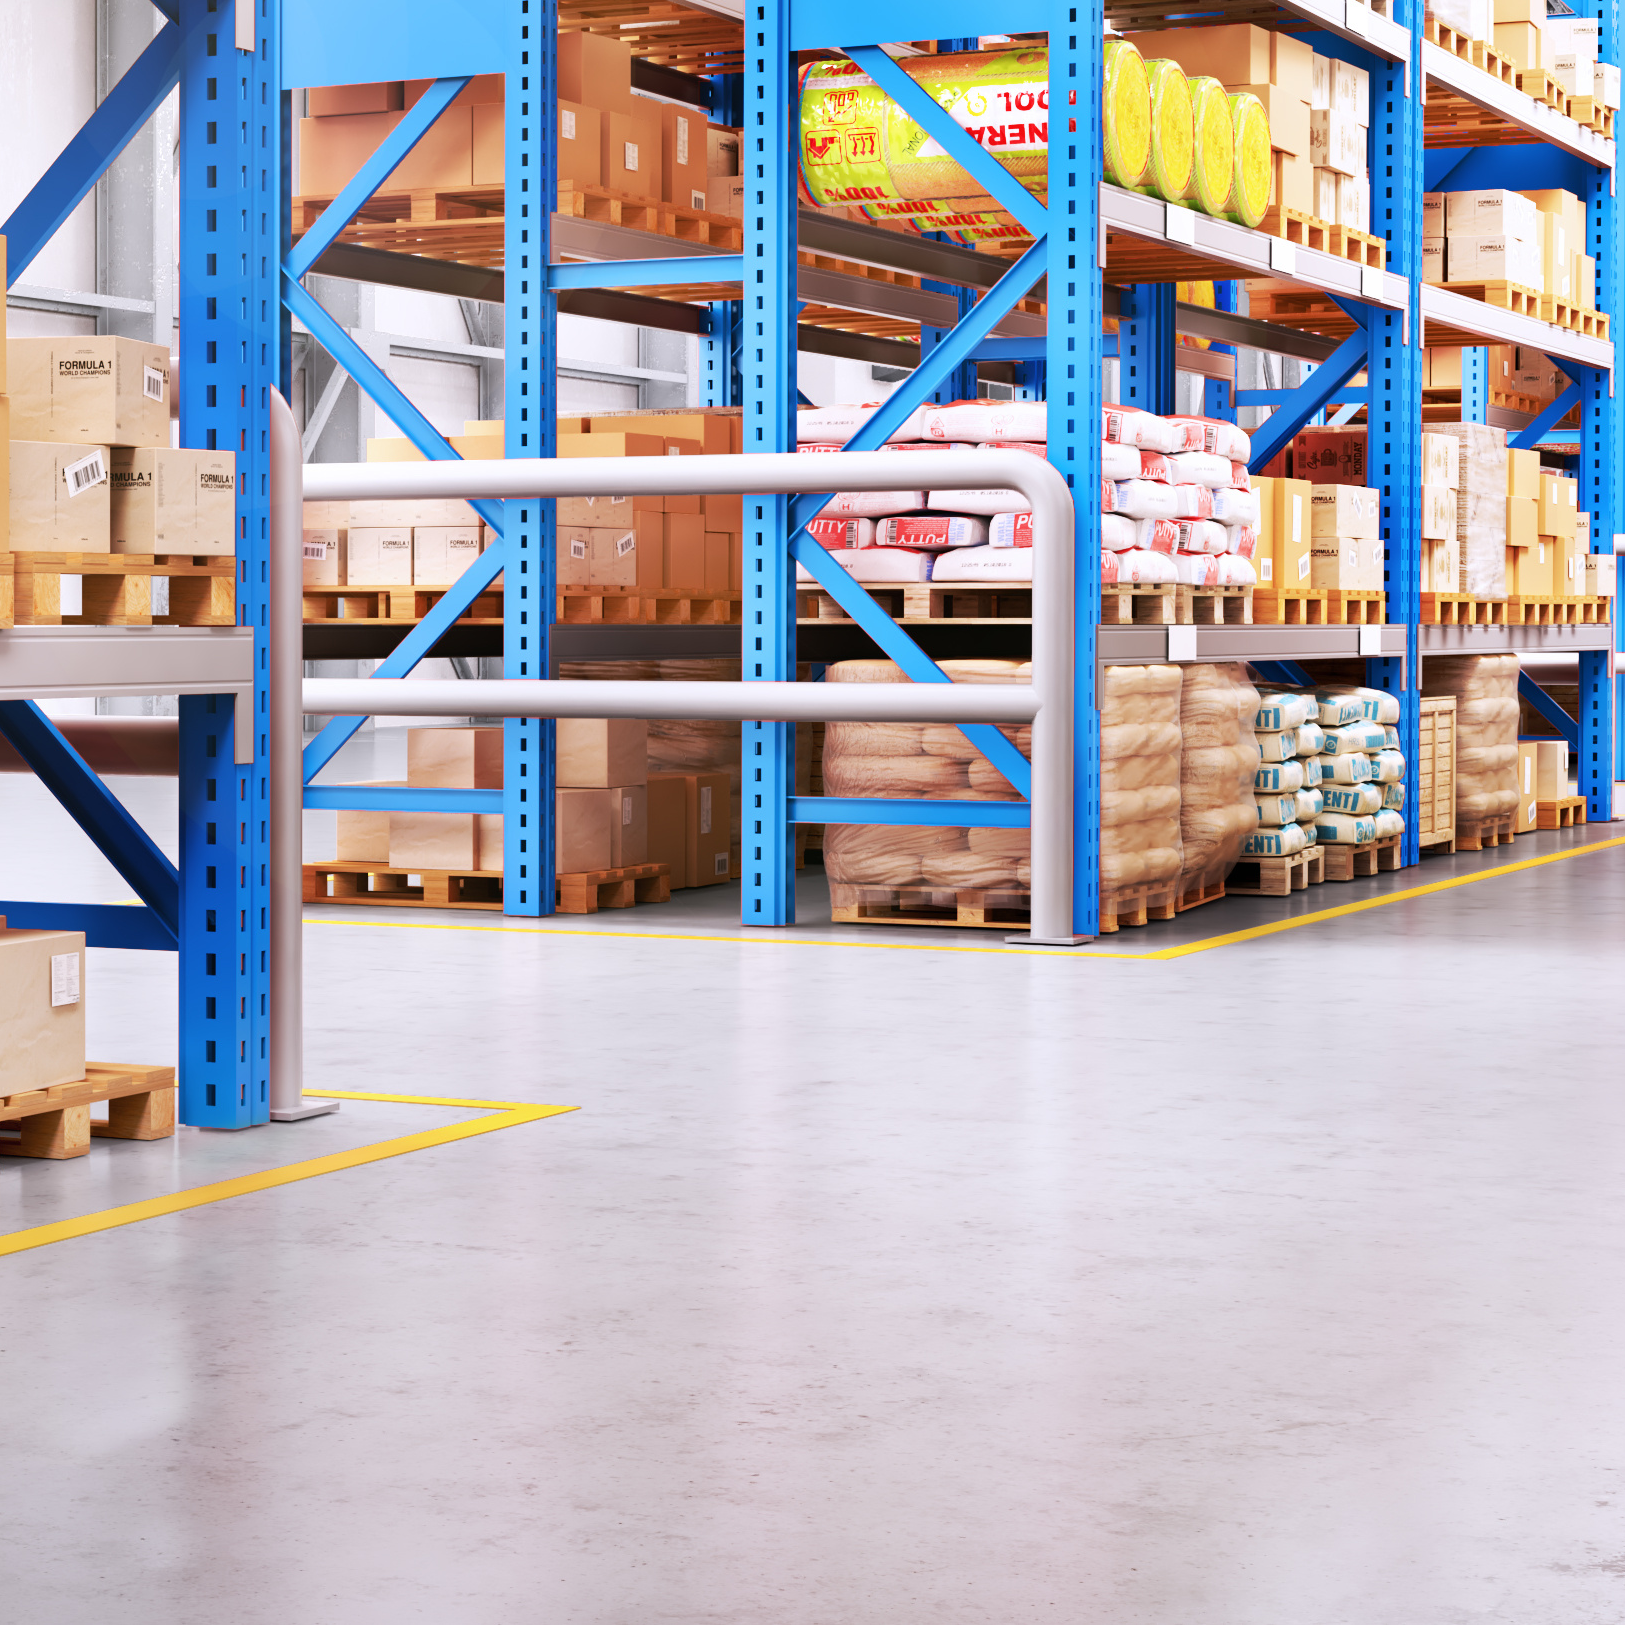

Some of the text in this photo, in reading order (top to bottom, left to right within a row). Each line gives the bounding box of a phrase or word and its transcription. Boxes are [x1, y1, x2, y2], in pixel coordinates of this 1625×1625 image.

[59, 360, 112, 370] FORMULA 1
[1354, 442, 1362, 475] MONDAY
[898, 533, 946, 544] PUTTY
